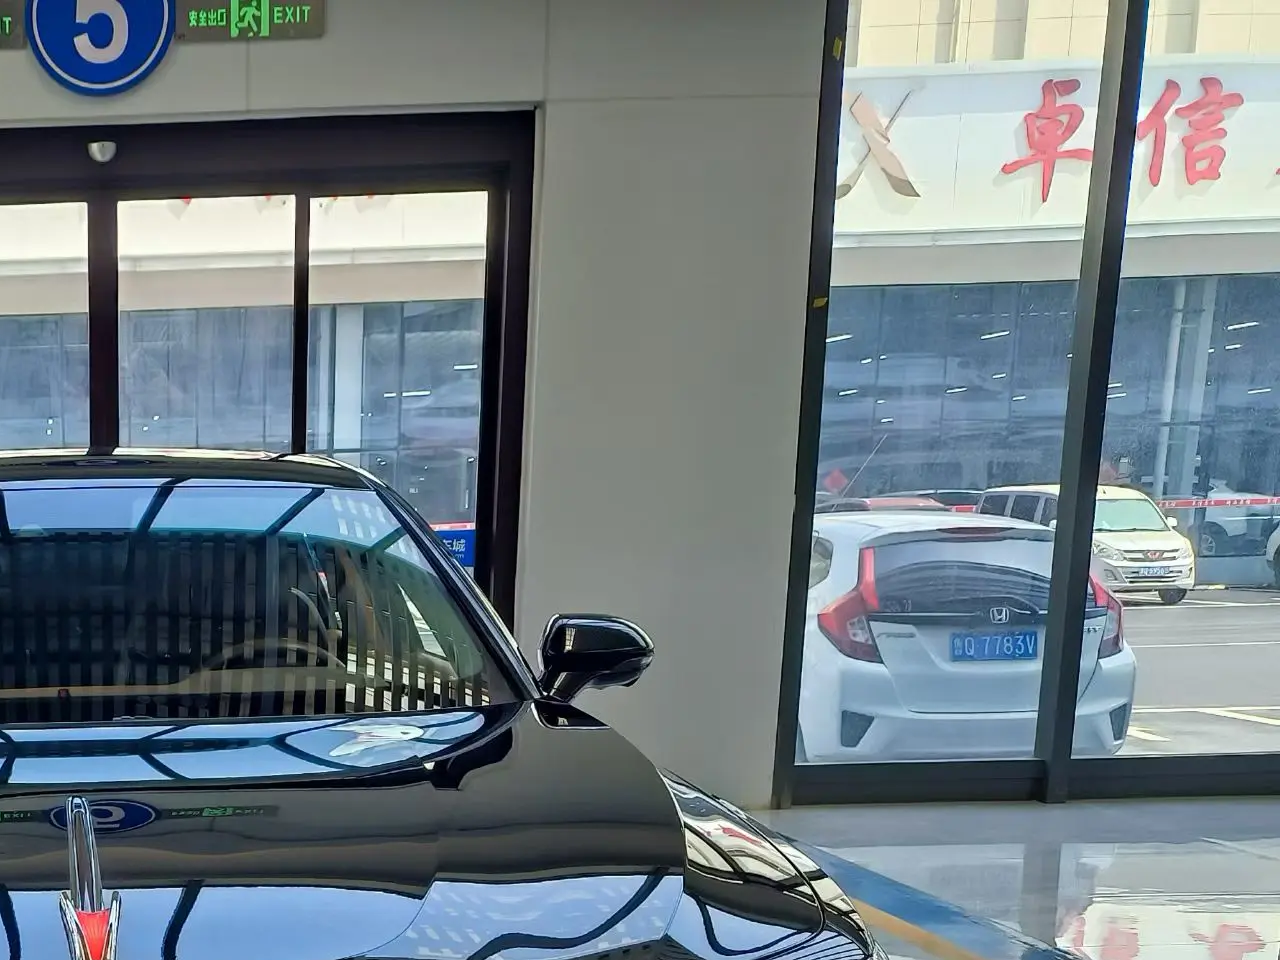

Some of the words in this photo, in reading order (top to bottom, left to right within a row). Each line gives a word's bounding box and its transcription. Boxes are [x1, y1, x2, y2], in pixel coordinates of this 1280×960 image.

[188, 9, 227, 27] 安全出口
[273, 6, 311, 24] EXIT
[73, 0, 129, 64] 5
